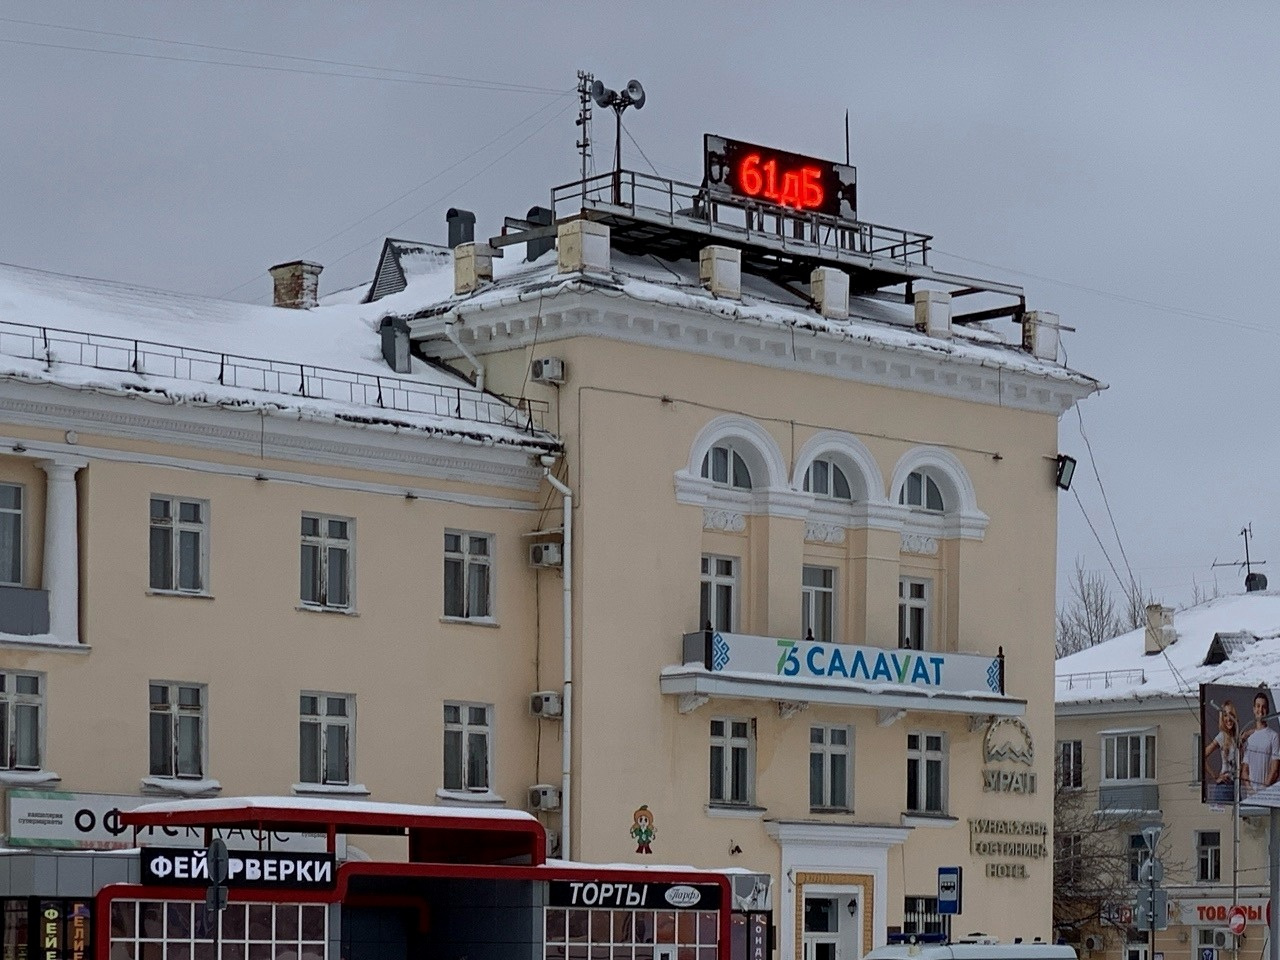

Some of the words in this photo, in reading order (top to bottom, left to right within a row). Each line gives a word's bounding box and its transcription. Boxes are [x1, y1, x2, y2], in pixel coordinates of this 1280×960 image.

[741, 154, 824, 211] 61дБ
[975, 841, 1049, 860] ГОСТИНИЦА
[150, 850, 332, 883] ФЕЙРВЕРКИ
[985, 863, 1031, 879] HOTEL
[570, 882, 648, 906] ТОРТЫ
